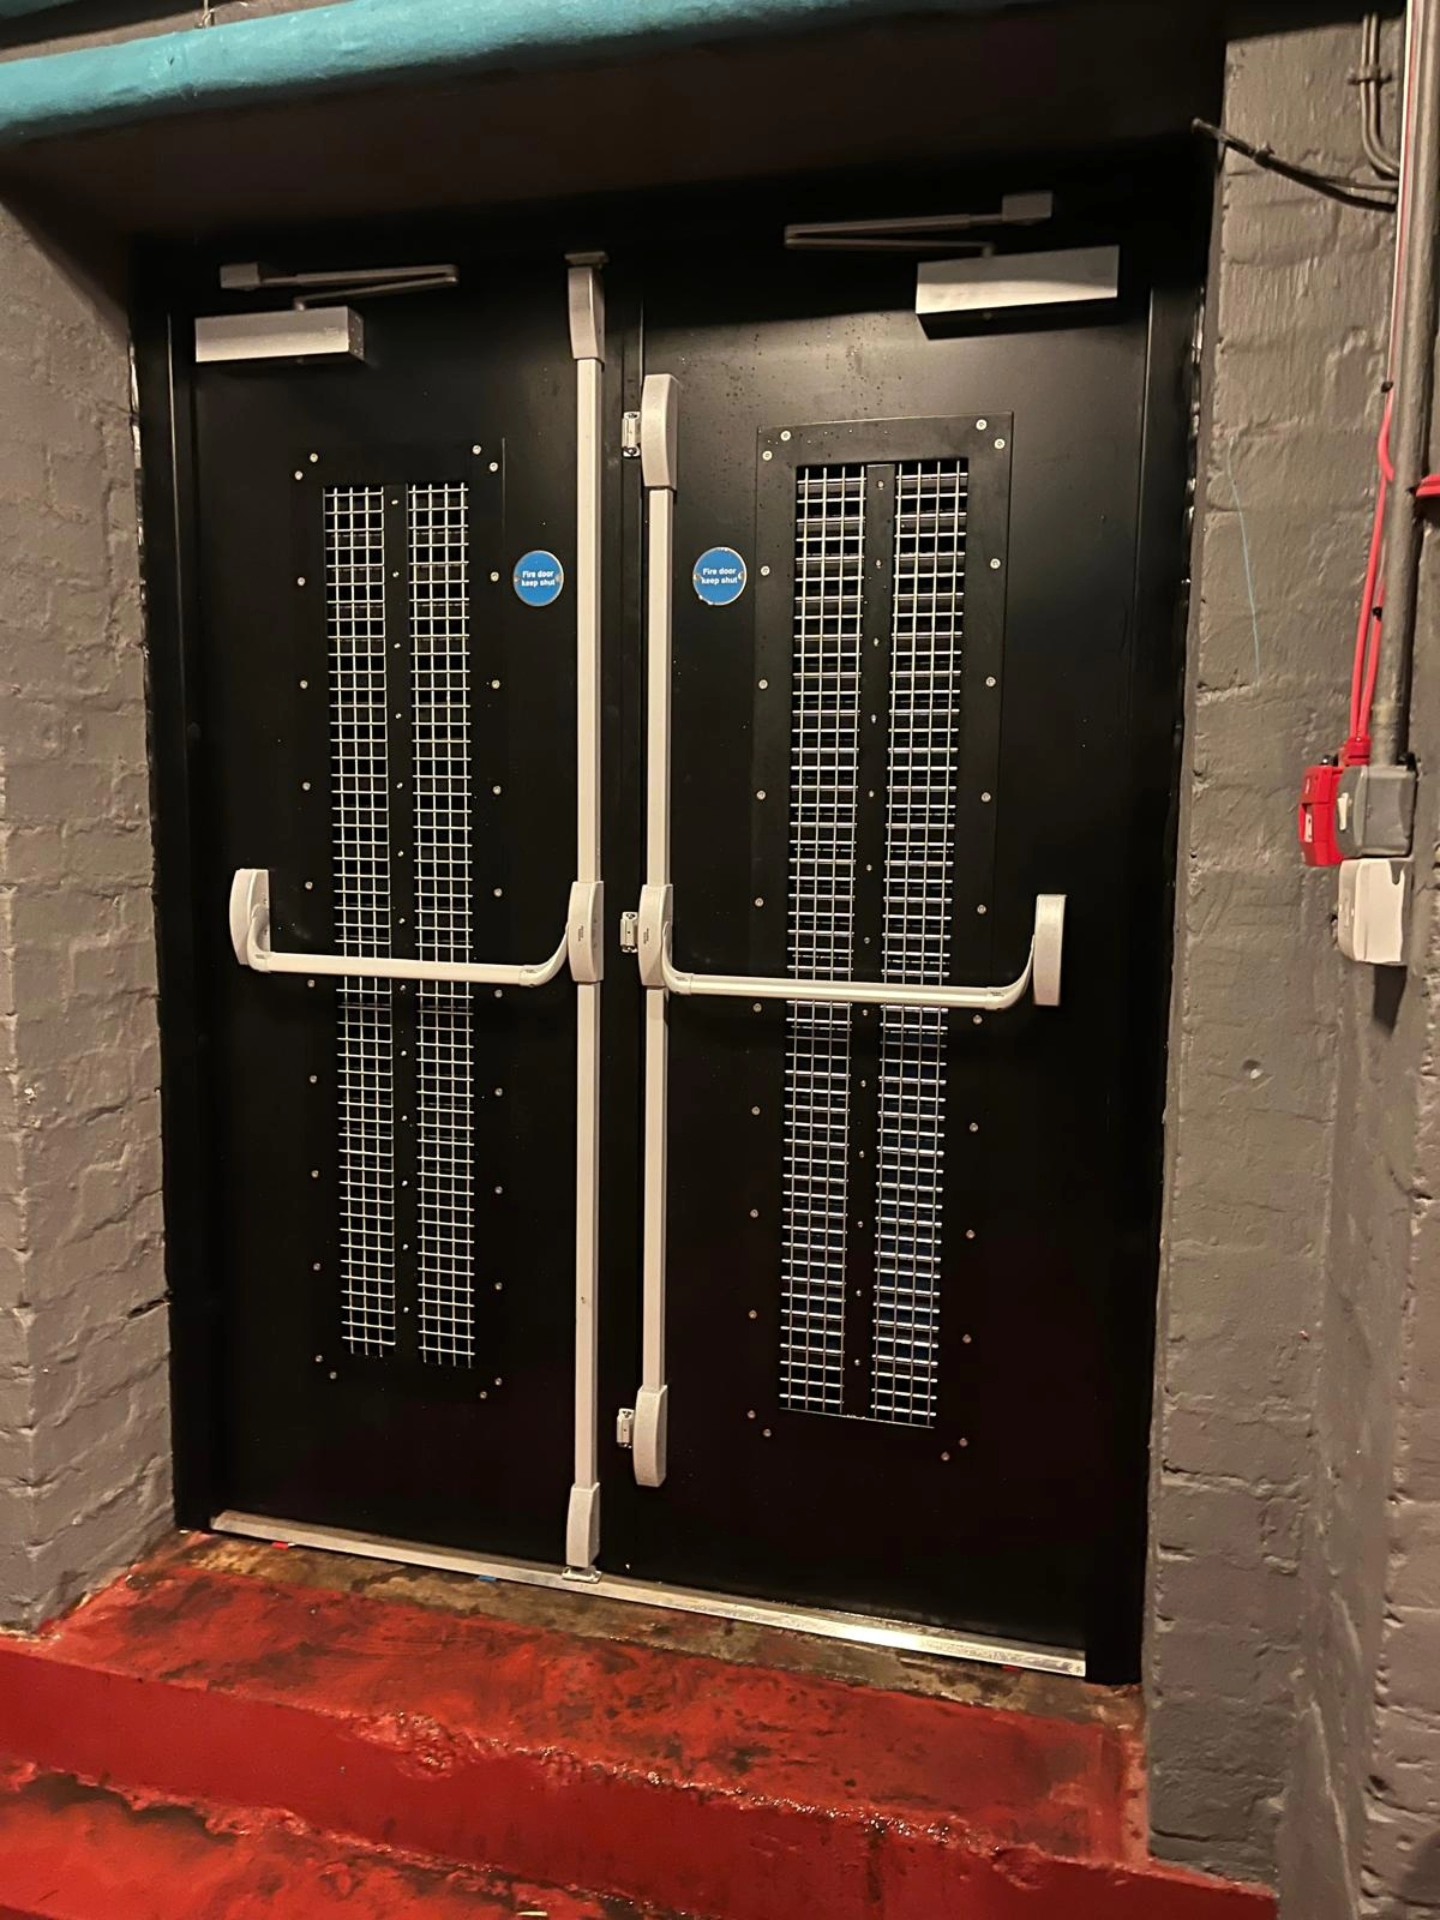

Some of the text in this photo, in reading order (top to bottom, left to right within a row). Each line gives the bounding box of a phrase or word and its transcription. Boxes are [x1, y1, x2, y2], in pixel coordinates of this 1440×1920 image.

[522, 570, 554, 578] Fire door
[521, 579, 555, 588] keep shut
[701, 576, 738, 586] keep shut
